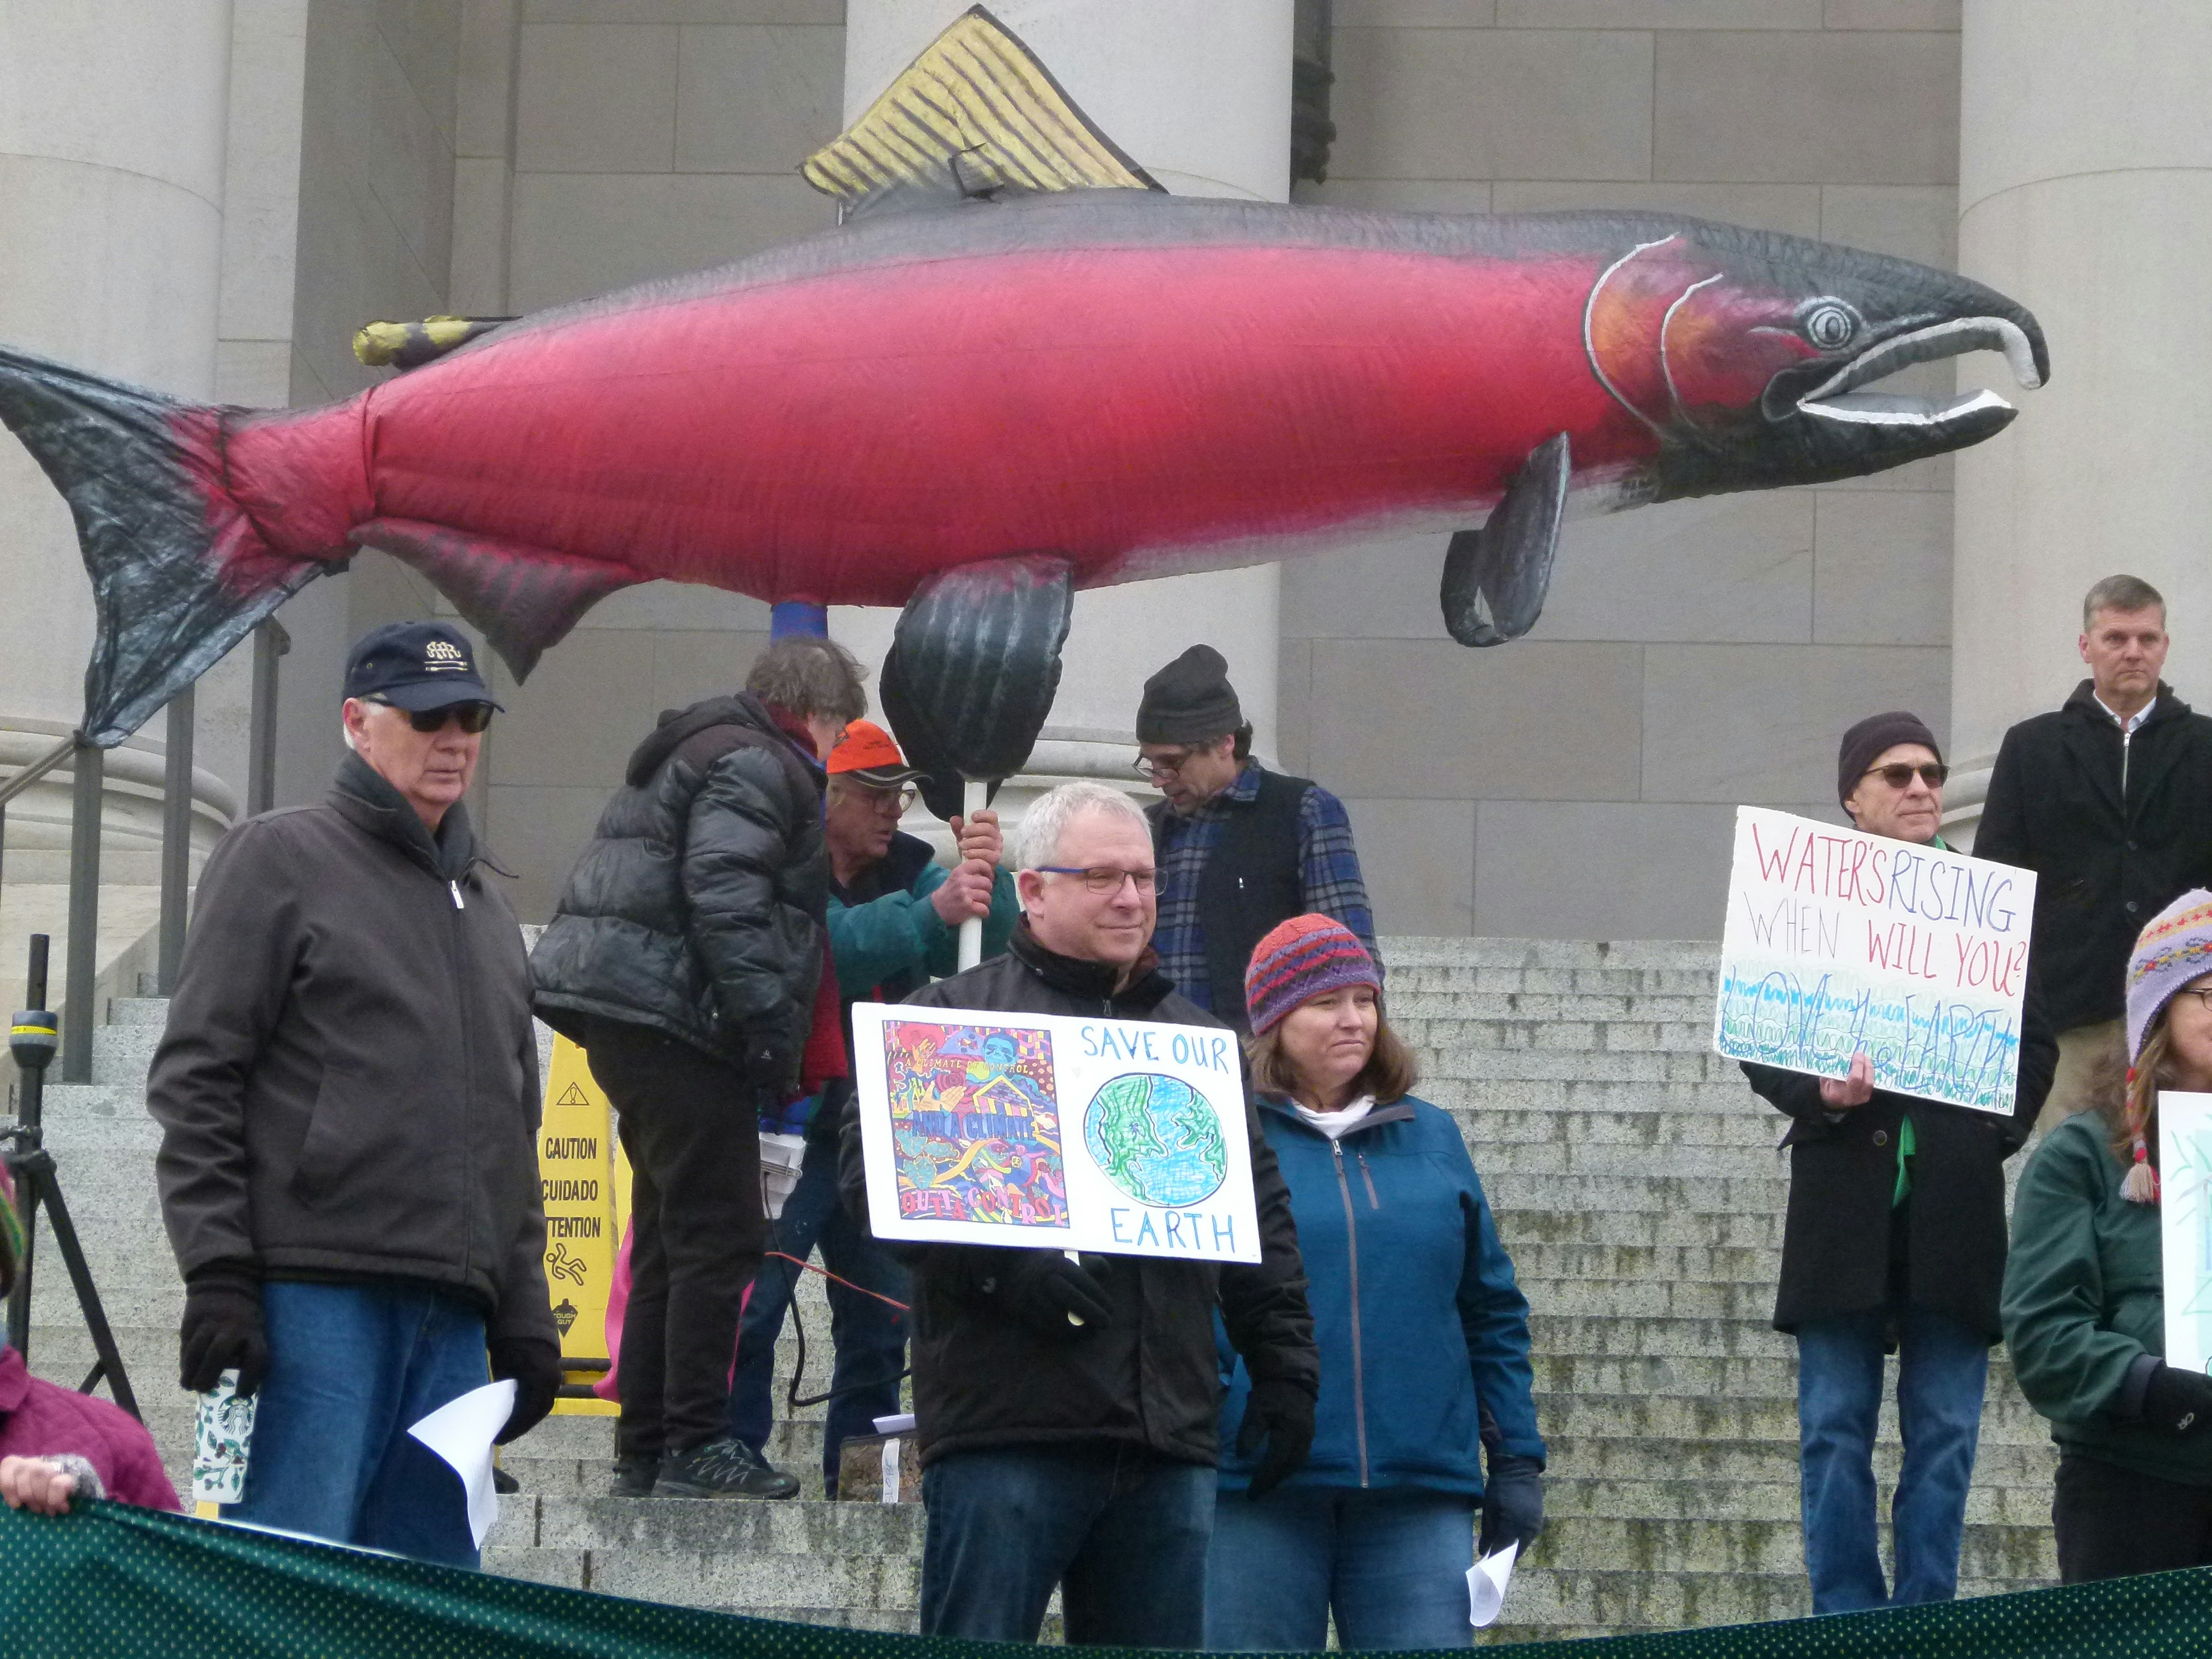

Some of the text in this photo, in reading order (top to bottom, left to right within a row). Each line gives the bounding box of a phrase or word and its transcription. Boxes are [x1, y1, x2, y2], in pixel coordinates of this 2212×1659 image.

[1889, 848, 2016, 932] RISING
[1743, 891, 2027, 996] WHEN WILL YOU?
[1081, 1026, 1229, 1074] SAVE OUR
[1721, 965, 1836, 1061] LOVE
[1898, 993, 2012, 1111] EARTH
[905, 1058, 1029, 1074] A CLIMATE OF CONTROL
[912, 1110, 1036, 1141] AND A CLIMATE
[545, 1137, 597, 1159] CAUTION
[542, 1179, 599, 1201] CUIDADO
[902, 1185, 1066, 1225] OUTTA CONTROL
[1111, 1208, 1235, 1253] EARTH
